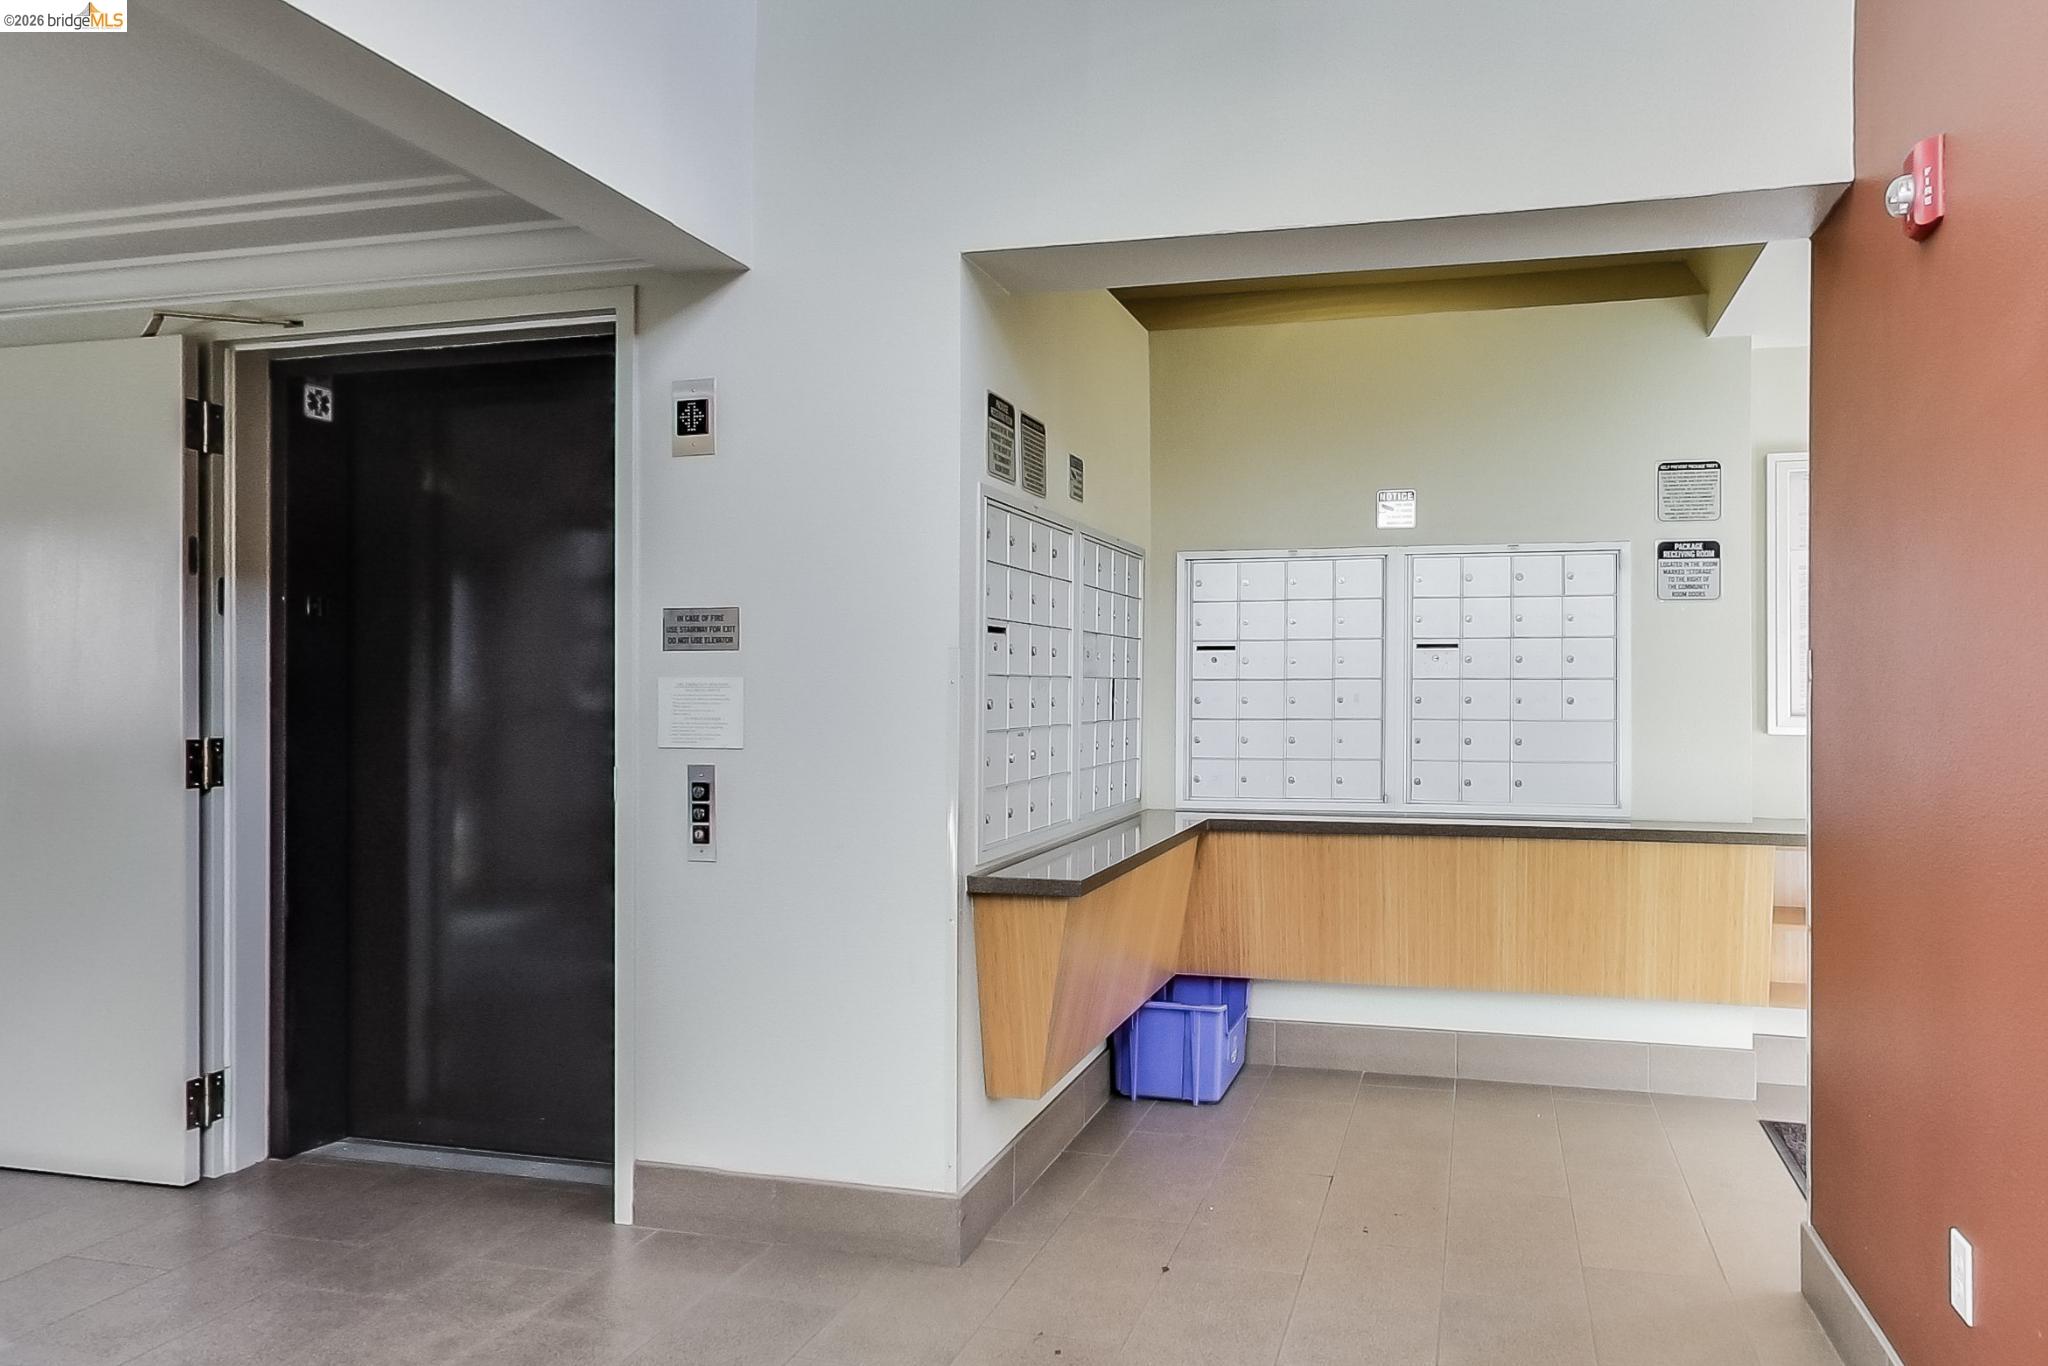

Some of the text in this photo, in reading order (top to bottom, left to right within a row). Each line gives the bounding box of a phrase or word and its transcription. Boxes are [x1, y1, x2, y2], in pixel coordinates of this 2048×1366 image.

[1379, 492, 1414, 501] NOTICE
[1674, 542, 1703, 550] PACKAGE
[1663, 550, 1696, 558] RECEIVING
[685, 614, 700, 622] CASE
[701, 614, 709, 622] OF
[679, 625, 708, 633] STAIRWAY
[667, 636, 734, 644] DO NOT USE ELEVATOR
